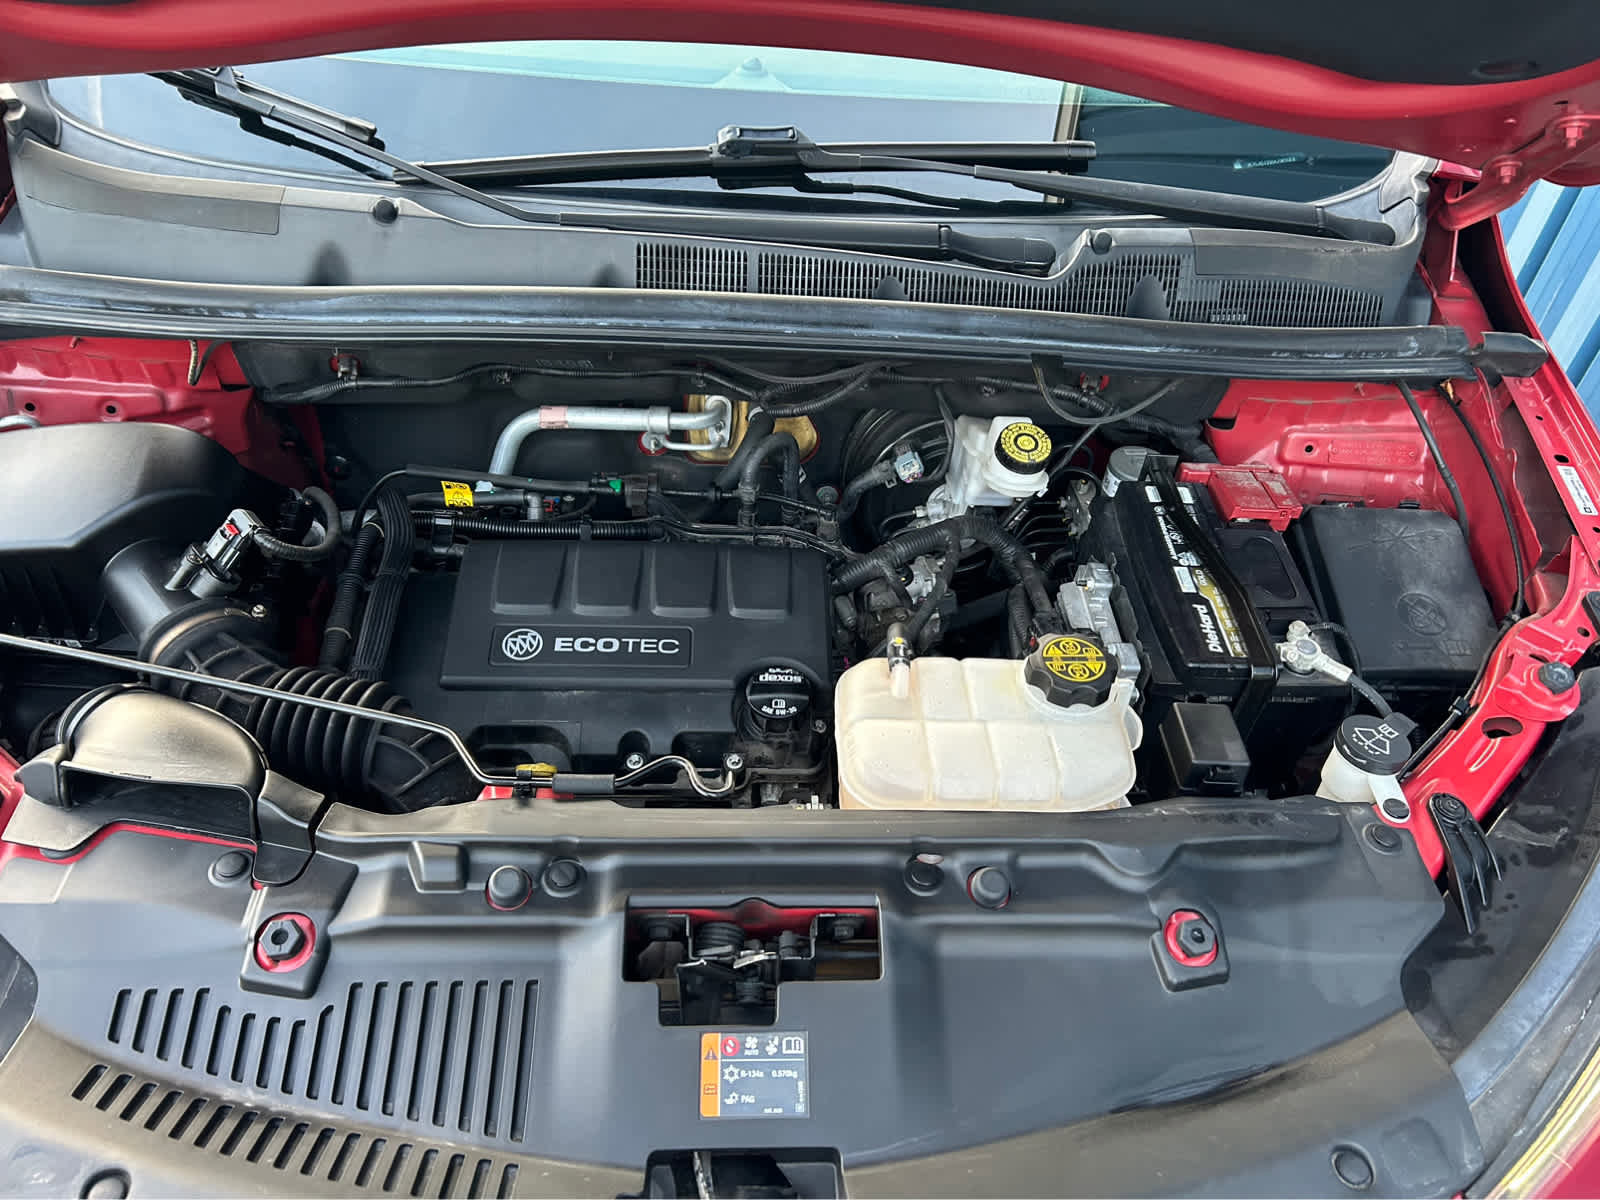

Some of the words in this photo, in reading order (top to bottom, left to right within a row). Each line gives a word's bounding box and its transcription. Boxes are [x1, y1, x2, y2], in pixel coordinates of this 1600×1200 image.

[1192, 604, 1224, 653] DieHard
[554, 637, 680, 654] ECOTEC
[759, 672, 802, 683] dexos
[740, 1069, 764, 1078] R-134a
[740, 1094, 755, 1104] PAG
